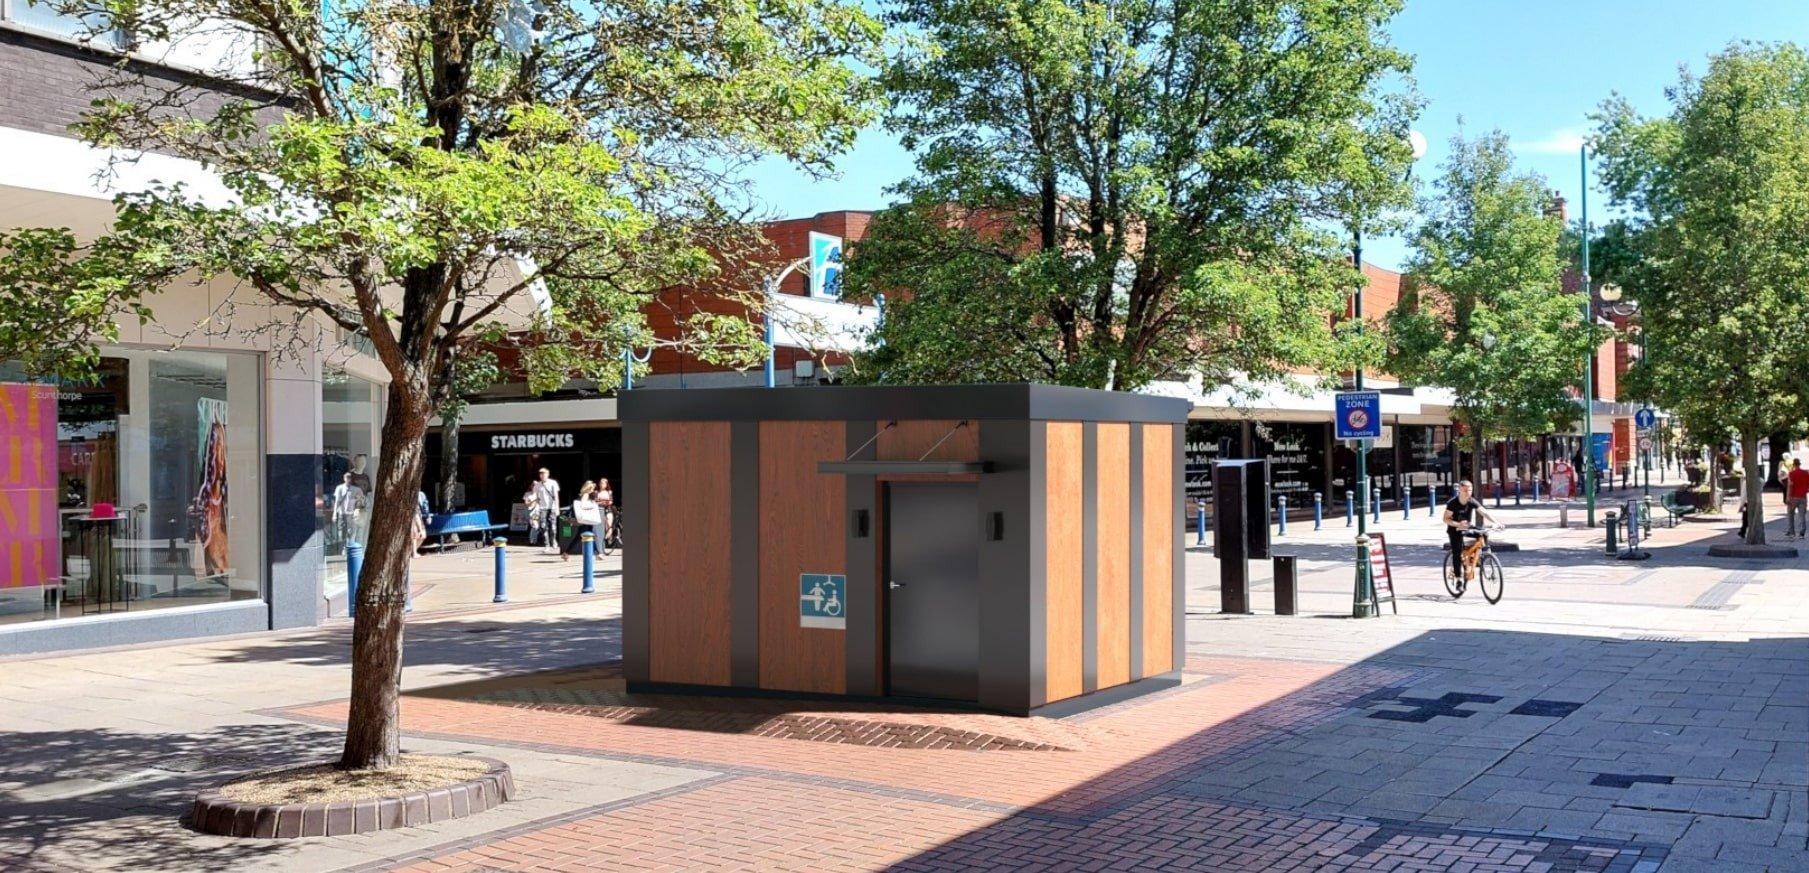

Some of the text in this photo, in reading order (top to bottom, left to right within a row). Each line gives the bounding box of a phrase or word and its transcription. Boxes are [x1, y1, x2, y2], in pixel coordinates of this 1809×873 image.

[32, 389, 82, 402] Scunthorpe
[1345, 400, 1370, 408] ZONE
[491, 434, 574, 448] STARBUCKS
[1274, 441, 1286, 451] New
